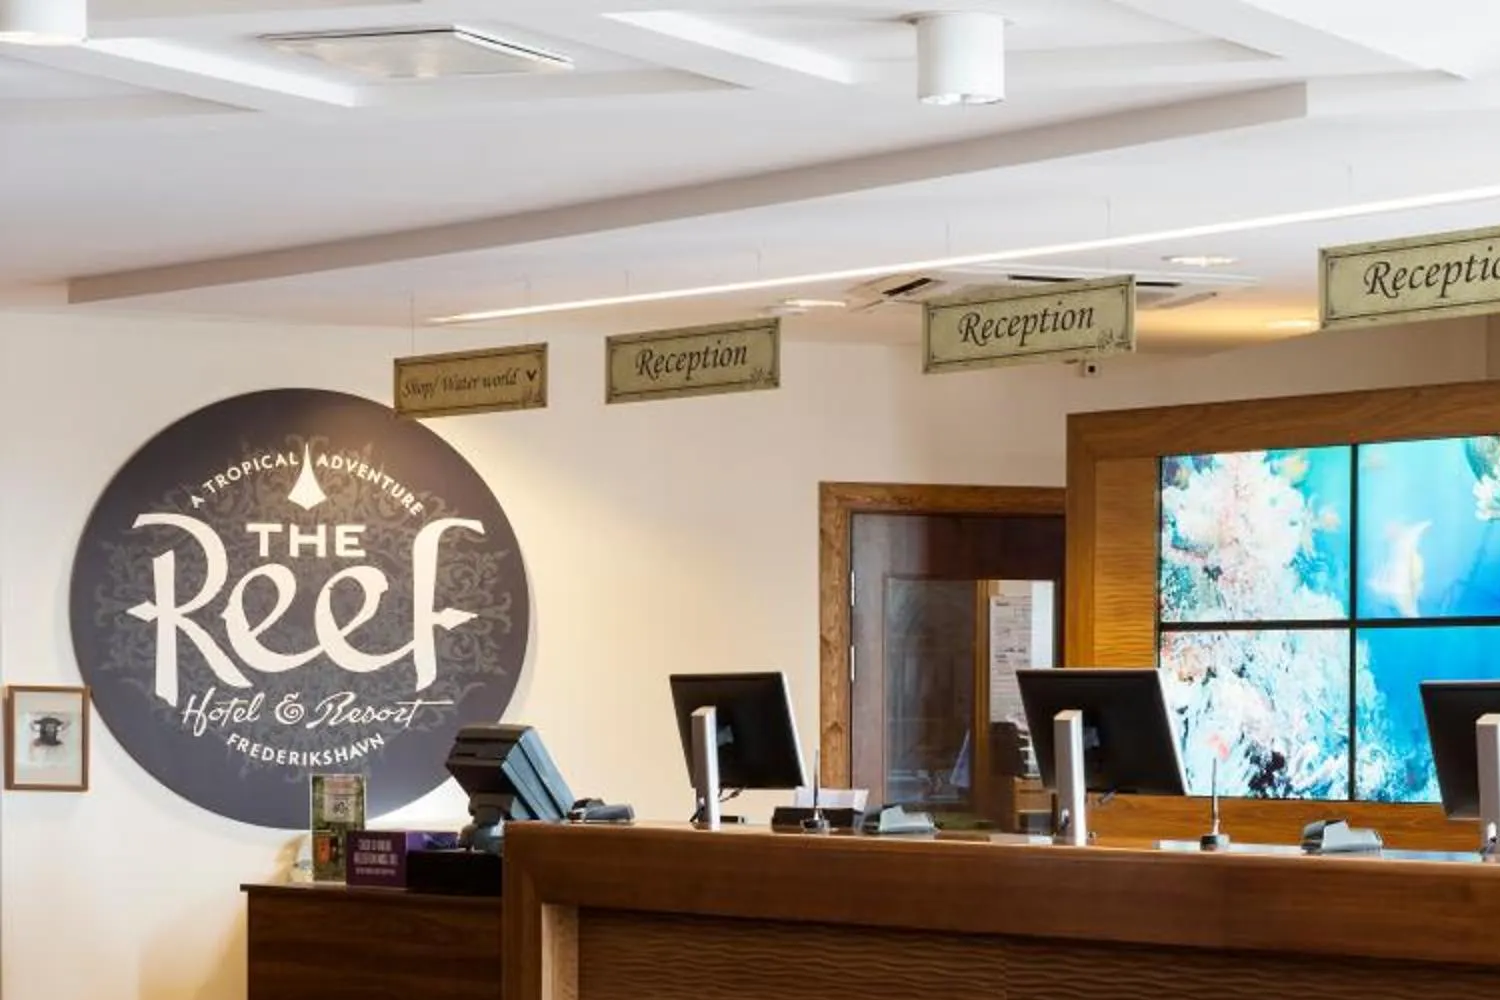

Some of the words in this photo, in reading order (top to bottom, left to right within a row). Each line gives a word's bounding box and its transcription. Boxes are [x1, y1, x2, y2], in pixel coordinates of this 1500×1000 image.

[957, 300, 1094, 347] Reception
[635, 339, 747, 381] Reception
[190, 495, 204, 508] A
[203, 452, 299, 493] TROPICAL
[316, 454, 423, 516] ADVENTURE
[246, 523, 366, 557] THE
[126, 513, 485, 708] Reef
[180, 687, 264, 736] Hotel
[274, 692, 305, 724] &
[306, 691, 454, 729] Resort
[227, 732, 386, 766] FREDERIKSHAVN
